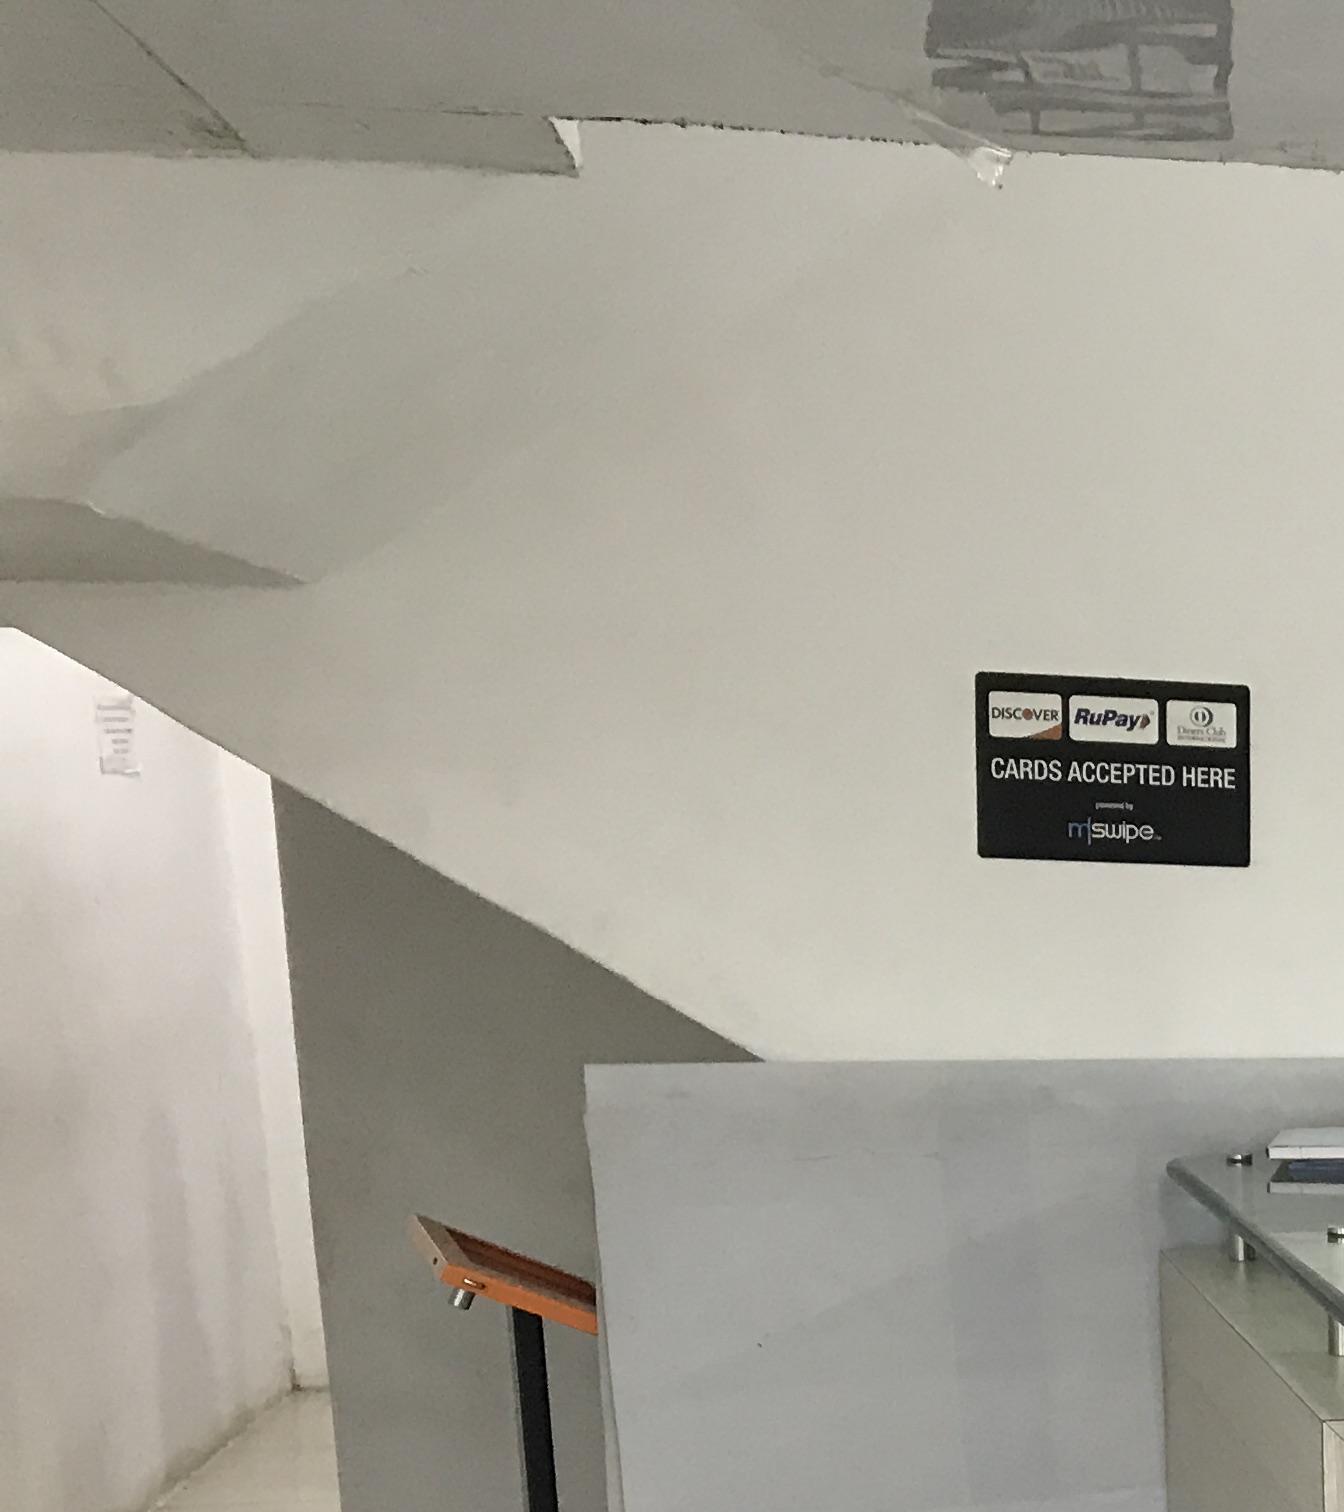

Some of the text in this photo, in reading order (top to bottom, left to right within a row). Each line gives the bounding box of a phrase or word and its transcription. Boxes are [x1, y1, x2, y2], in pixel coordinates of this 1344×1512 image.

[992, 706, 1059, 722] DISCOVER
[1074, 708, 1140, 731] RuPay
[991, 757, 1236, 790] CARDS ACCEPTED HERE
